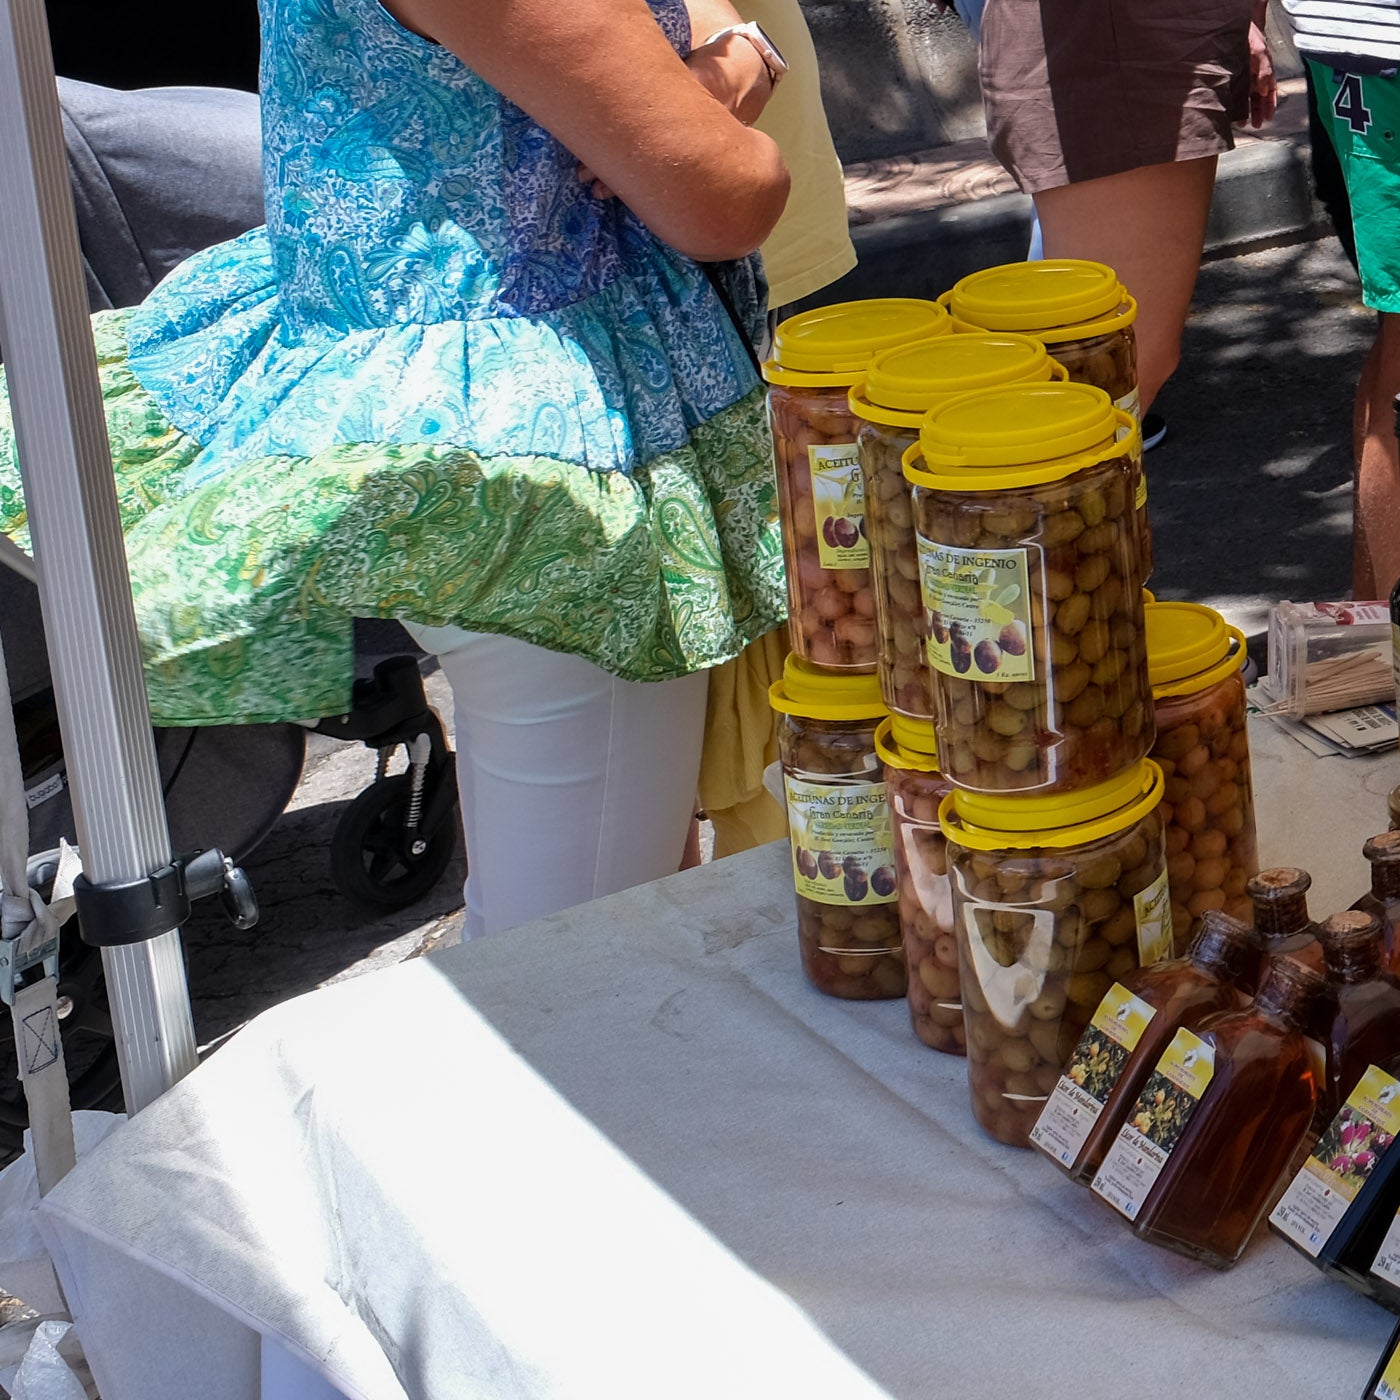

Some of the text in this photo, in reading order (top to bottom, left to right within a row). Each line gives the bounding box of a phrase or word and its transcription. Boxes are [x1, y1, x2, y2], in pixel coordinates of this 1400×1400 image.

[1333, 73, 1372, 135] 4
[946, 554, 1017, 570] DE INGENIO
[942, 568, 979, 585] Canaria
[837, 796, 853, 806] DE
[810, 806, 873, 820] Gran Canaria
